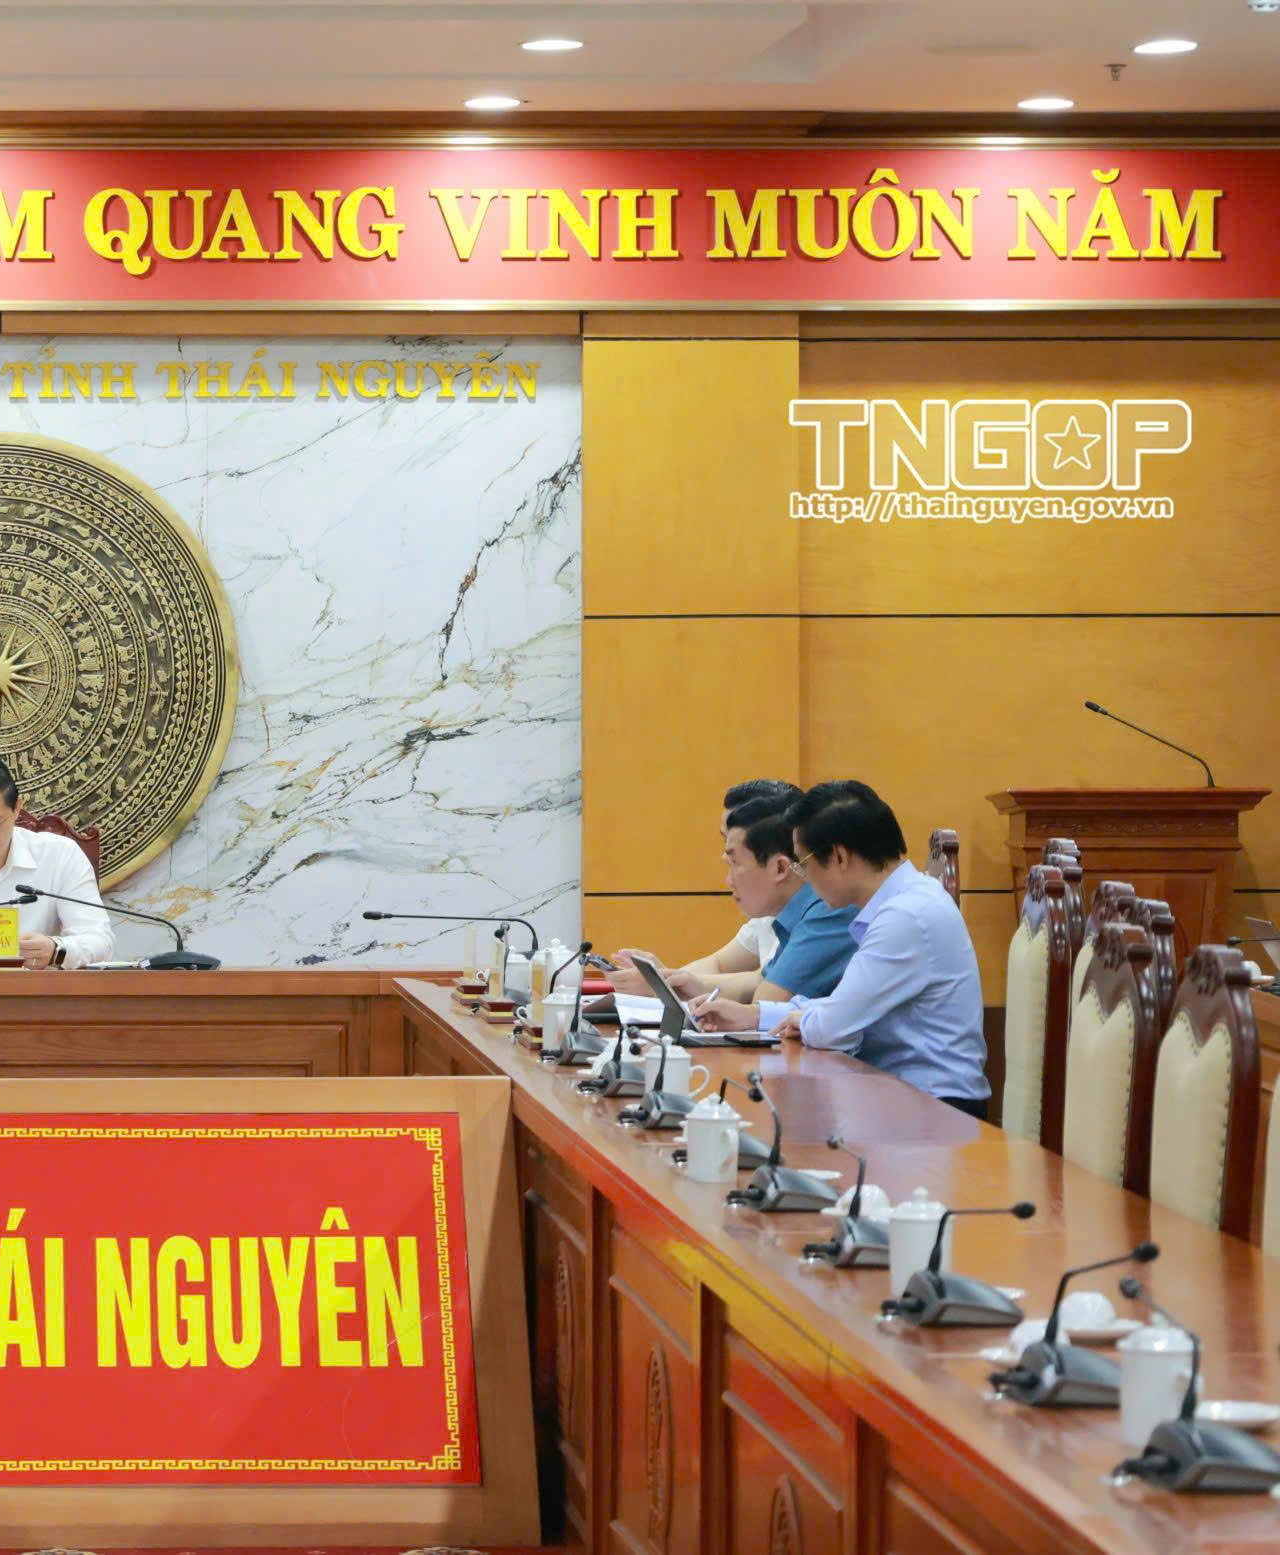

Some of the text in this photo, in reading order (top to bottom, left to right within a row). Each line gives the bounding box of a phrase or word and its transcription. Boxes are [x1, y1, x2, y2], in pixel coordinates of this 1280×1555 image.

[83, 186, 405, 276] QUANG
[429, 188, 679, 260] VINH
[706, 168, 980, 260] MUÔN
[1007, 168, 1224, 260] NĂM
[1, 346, 137, 401] TỈNH
[156, 347, 297, 400] THÁI
[317, 352, 542, 402] NGUYÊN
[95, 1207, 424, 1370] NGUYÊN
